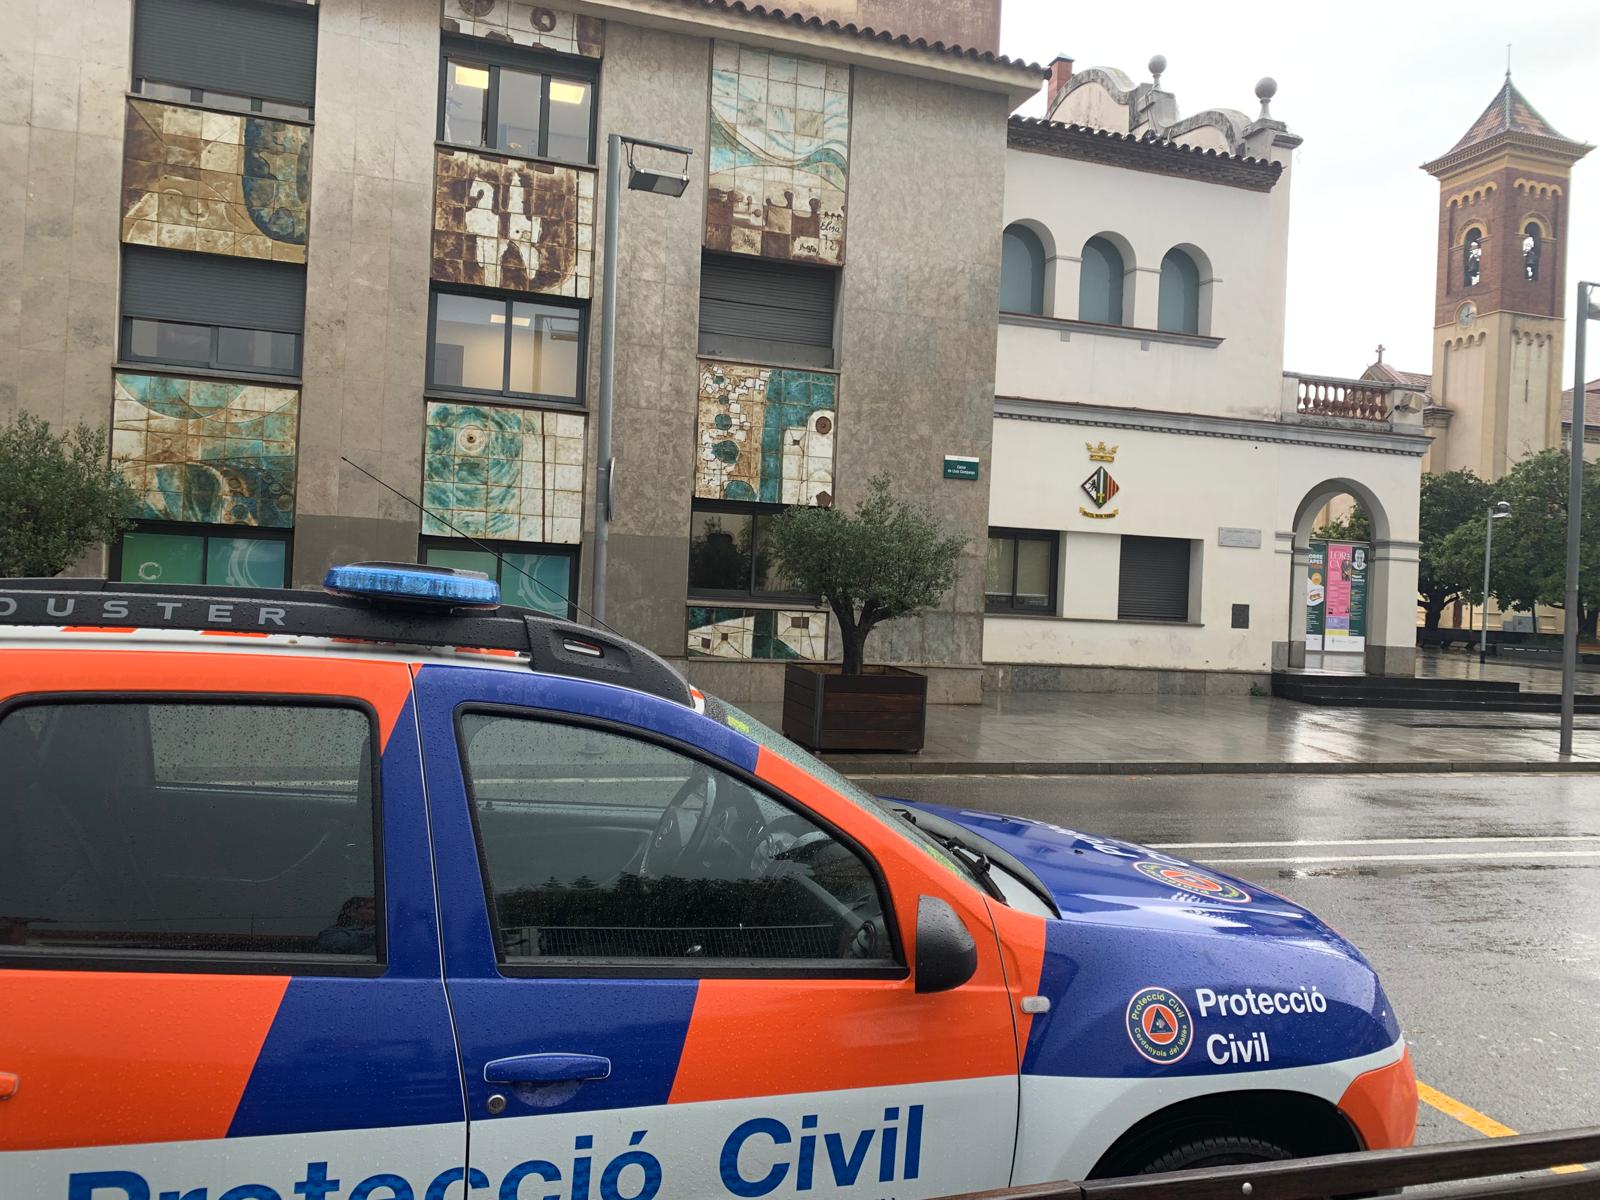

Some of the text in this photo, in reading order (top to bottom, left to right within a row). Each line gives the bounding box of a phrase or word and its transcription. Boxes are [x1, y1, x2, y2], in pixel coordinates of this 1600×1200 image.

[0, 597, 286, 627] DUSTER
[1131, 993, 1185, 1020] Protecció Civil
[1195, 985, 1327, 1018] Protecció
[1134, 1027, 1167, 1057] Cerdanyola
[1169, 1045, 1180, 1056] del
[1206, 1031, 1270, 1066] Civil
[67, 1103, 925, 1200] tcció Civil
